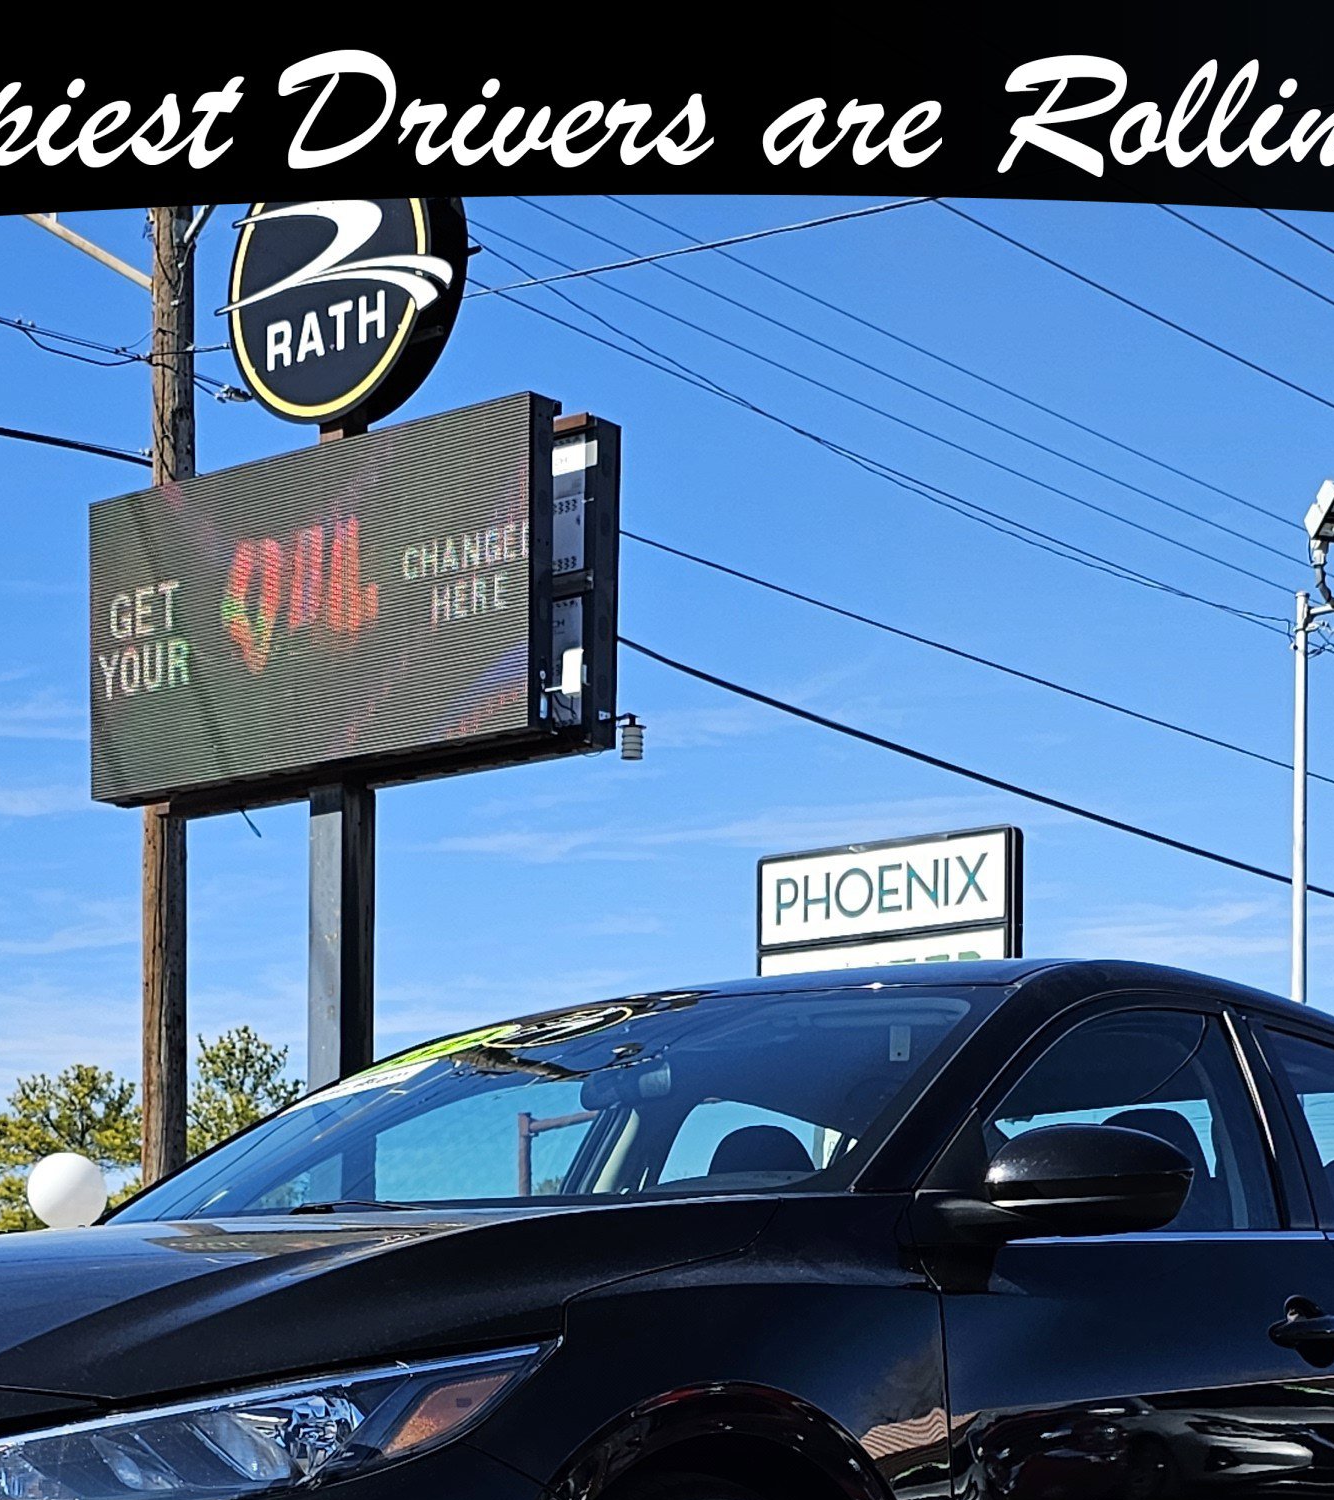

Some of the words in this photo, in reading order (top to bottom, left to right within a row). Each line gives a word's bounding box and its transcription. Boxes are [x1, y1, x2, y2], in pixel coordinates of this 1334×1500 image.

[267, 290, 386, 372] RATH
[110, 580, 180, 638] GET
[432, 571, 508, 628] HERE
[98, 640, 190, 700] YOUR
[775, 852, 988, 926] PHOENIX
